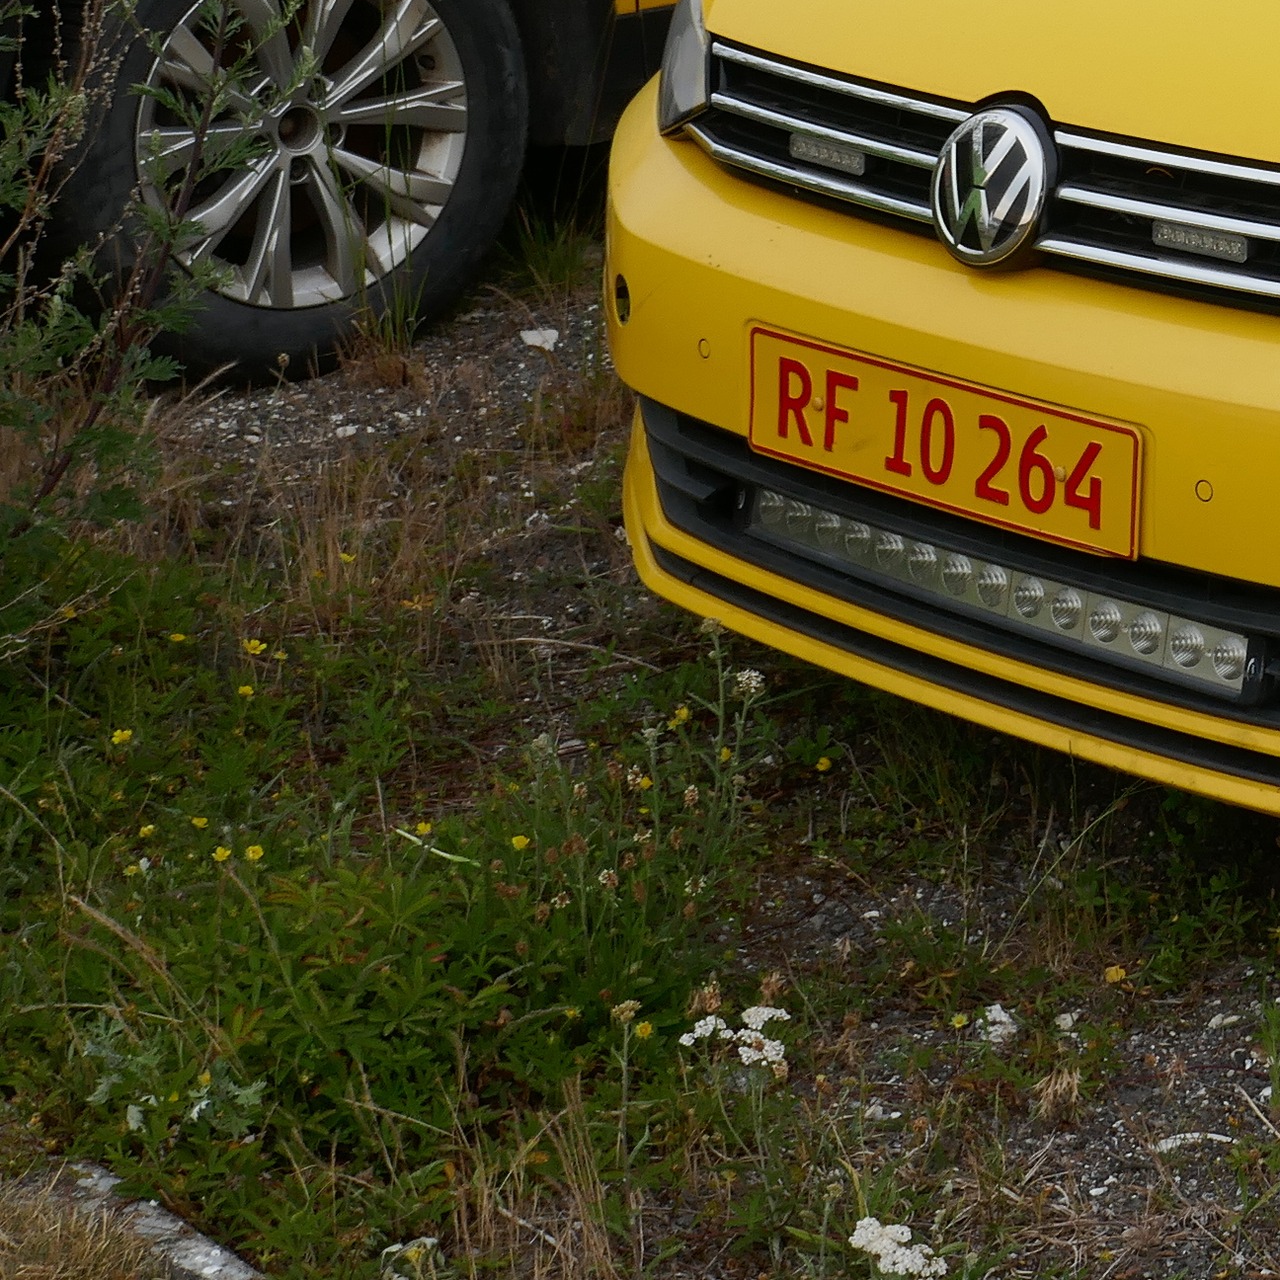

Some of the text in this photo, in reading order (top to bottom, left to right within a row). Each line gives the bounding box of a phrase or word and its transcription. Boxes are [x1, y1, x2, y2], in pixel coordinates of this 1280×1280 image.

[777, 356, 1103, 531] RF 10 264
